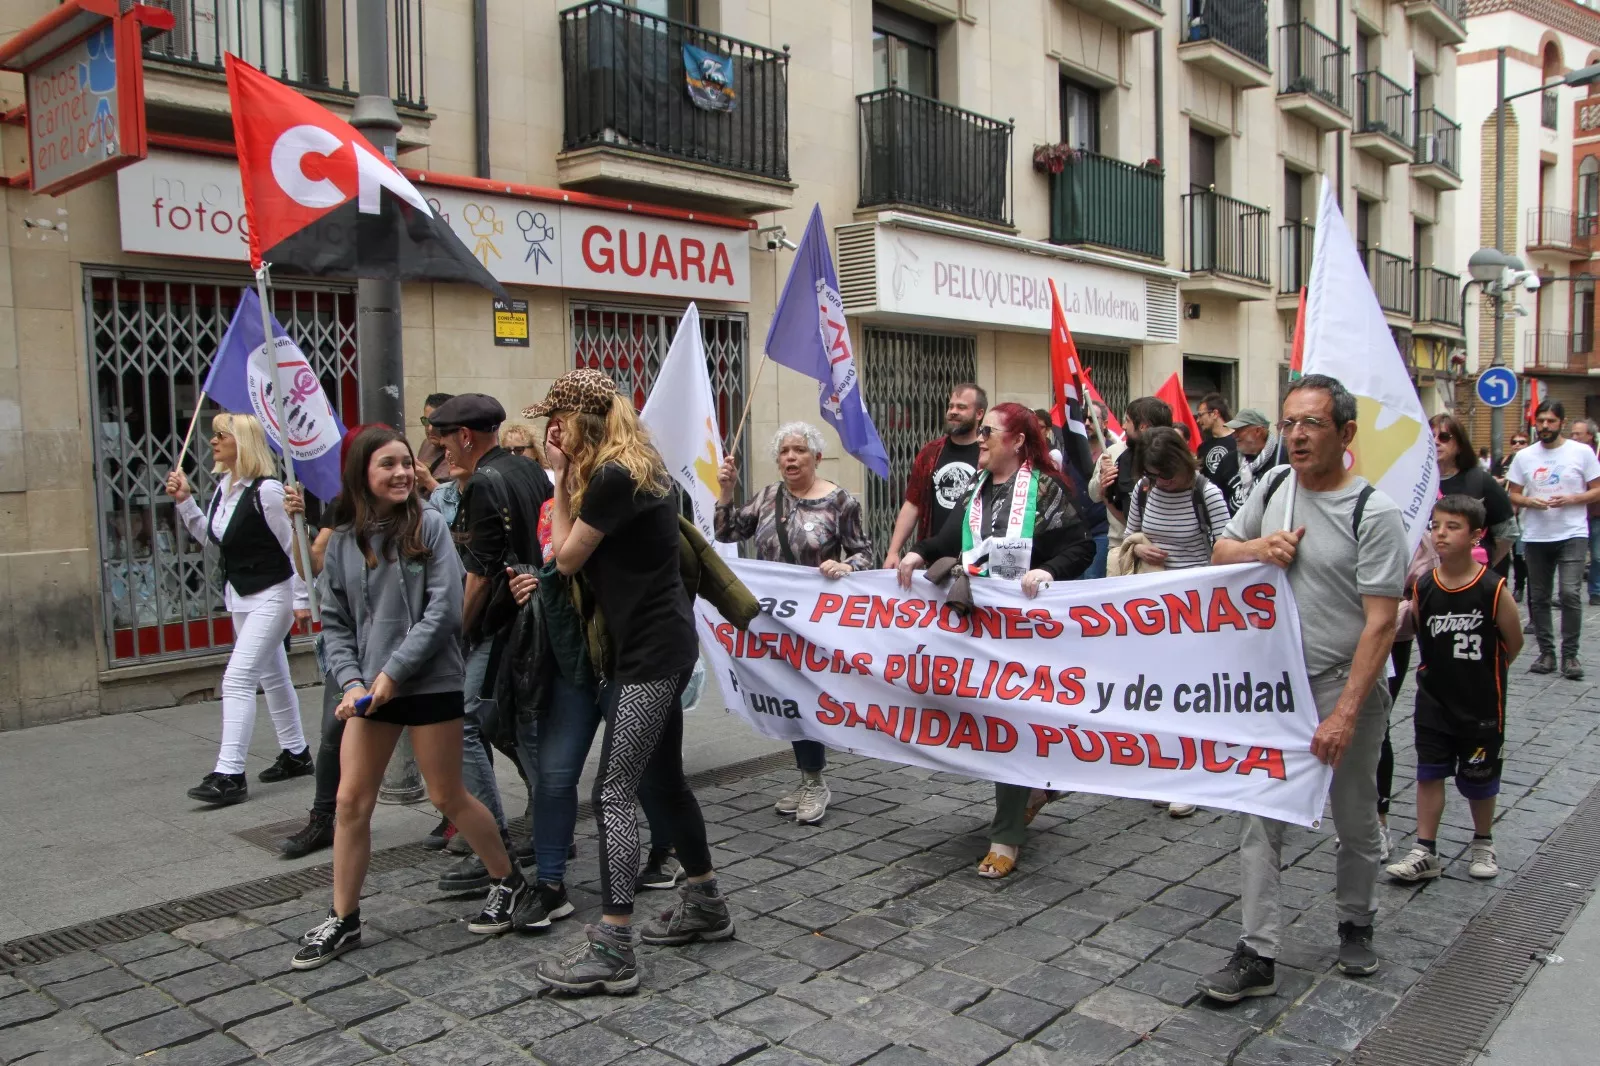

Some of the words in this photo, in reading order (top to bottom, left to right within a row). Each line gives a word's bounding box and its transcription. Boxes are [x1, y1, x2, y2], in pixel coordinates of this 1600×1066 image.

[35, 65, 77, 109] fotos
[37, 89, 88, 138] carnet
[38, 142, 57, 170] en
[60, 125, 74, 160] el
[77, 114, 115, 153] acto
[582, 225, 735, 286] GUARA
[933, 261, 1050, 311] PELUQUERIA
[1063, 282, 1081, 313] La
[1085, 286, 1139, 322] Moderna
[295, 443, 327, 458] Pensiones
[759, 597, 799, 619] as
[808, 592, 1064, 640] PENSIONES
[1069, 582, 1277, 638] DIGNAS
[704, 620, 874, 677] SIDENCIAS
[883, 644, 1087, 706] PÚBLICAS
[1090, 682, 1115, 714] y
[1123, 674, 1163, 712] de
[1173, 671, 1295, 713] calidad
[1453, 632, 1483, 661] 23
[749, 692, 803, 719] una
[815, 690, 1019, 754] SANIDAD
[1028, 723, 1287, 781] PÚBLICA
